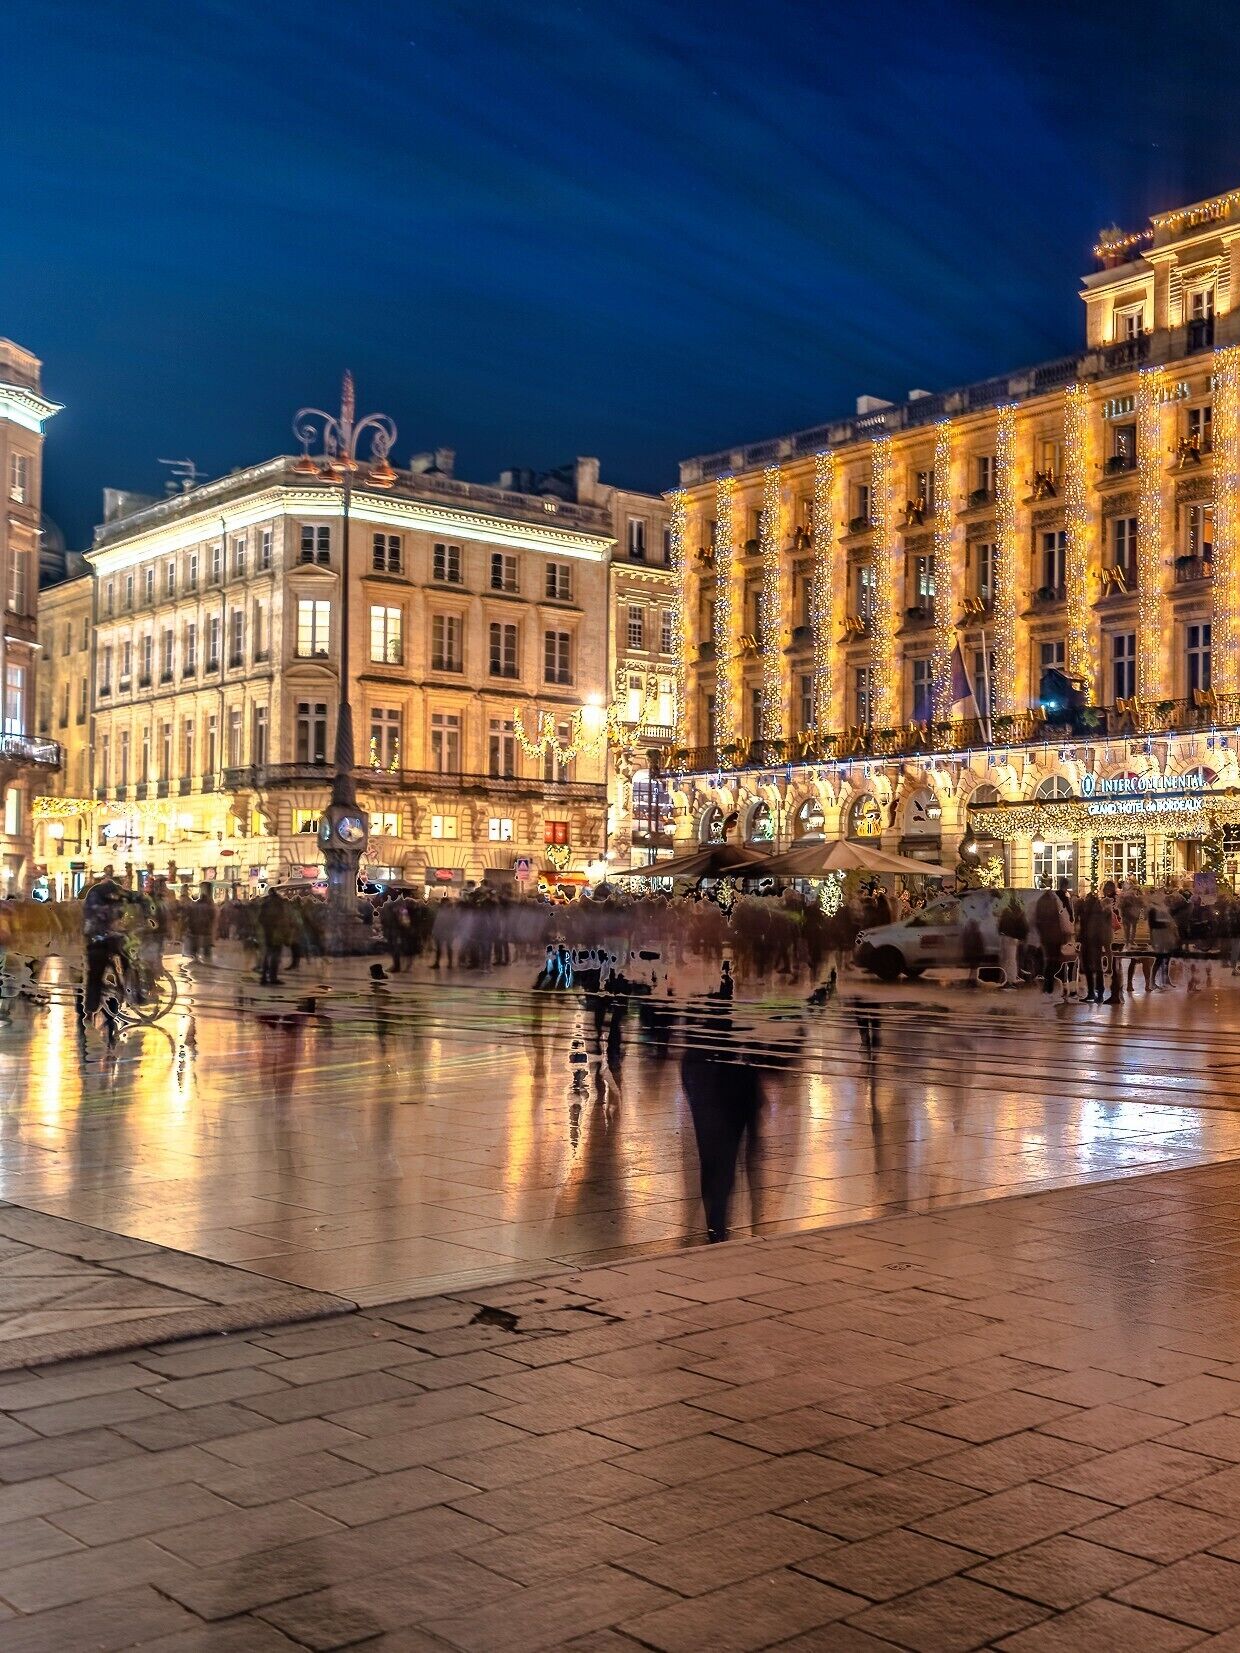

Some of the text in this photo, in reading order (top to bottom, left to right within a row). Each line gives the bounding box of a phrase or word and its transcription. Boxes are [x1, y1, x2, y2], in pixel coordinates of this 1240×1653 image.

[1101, 774, 1203, 792] INTERCONTINENTAL
[1088, 802, 1117, 815] GRAND
[1157, 797, 1204, 812] BORDEAUX
